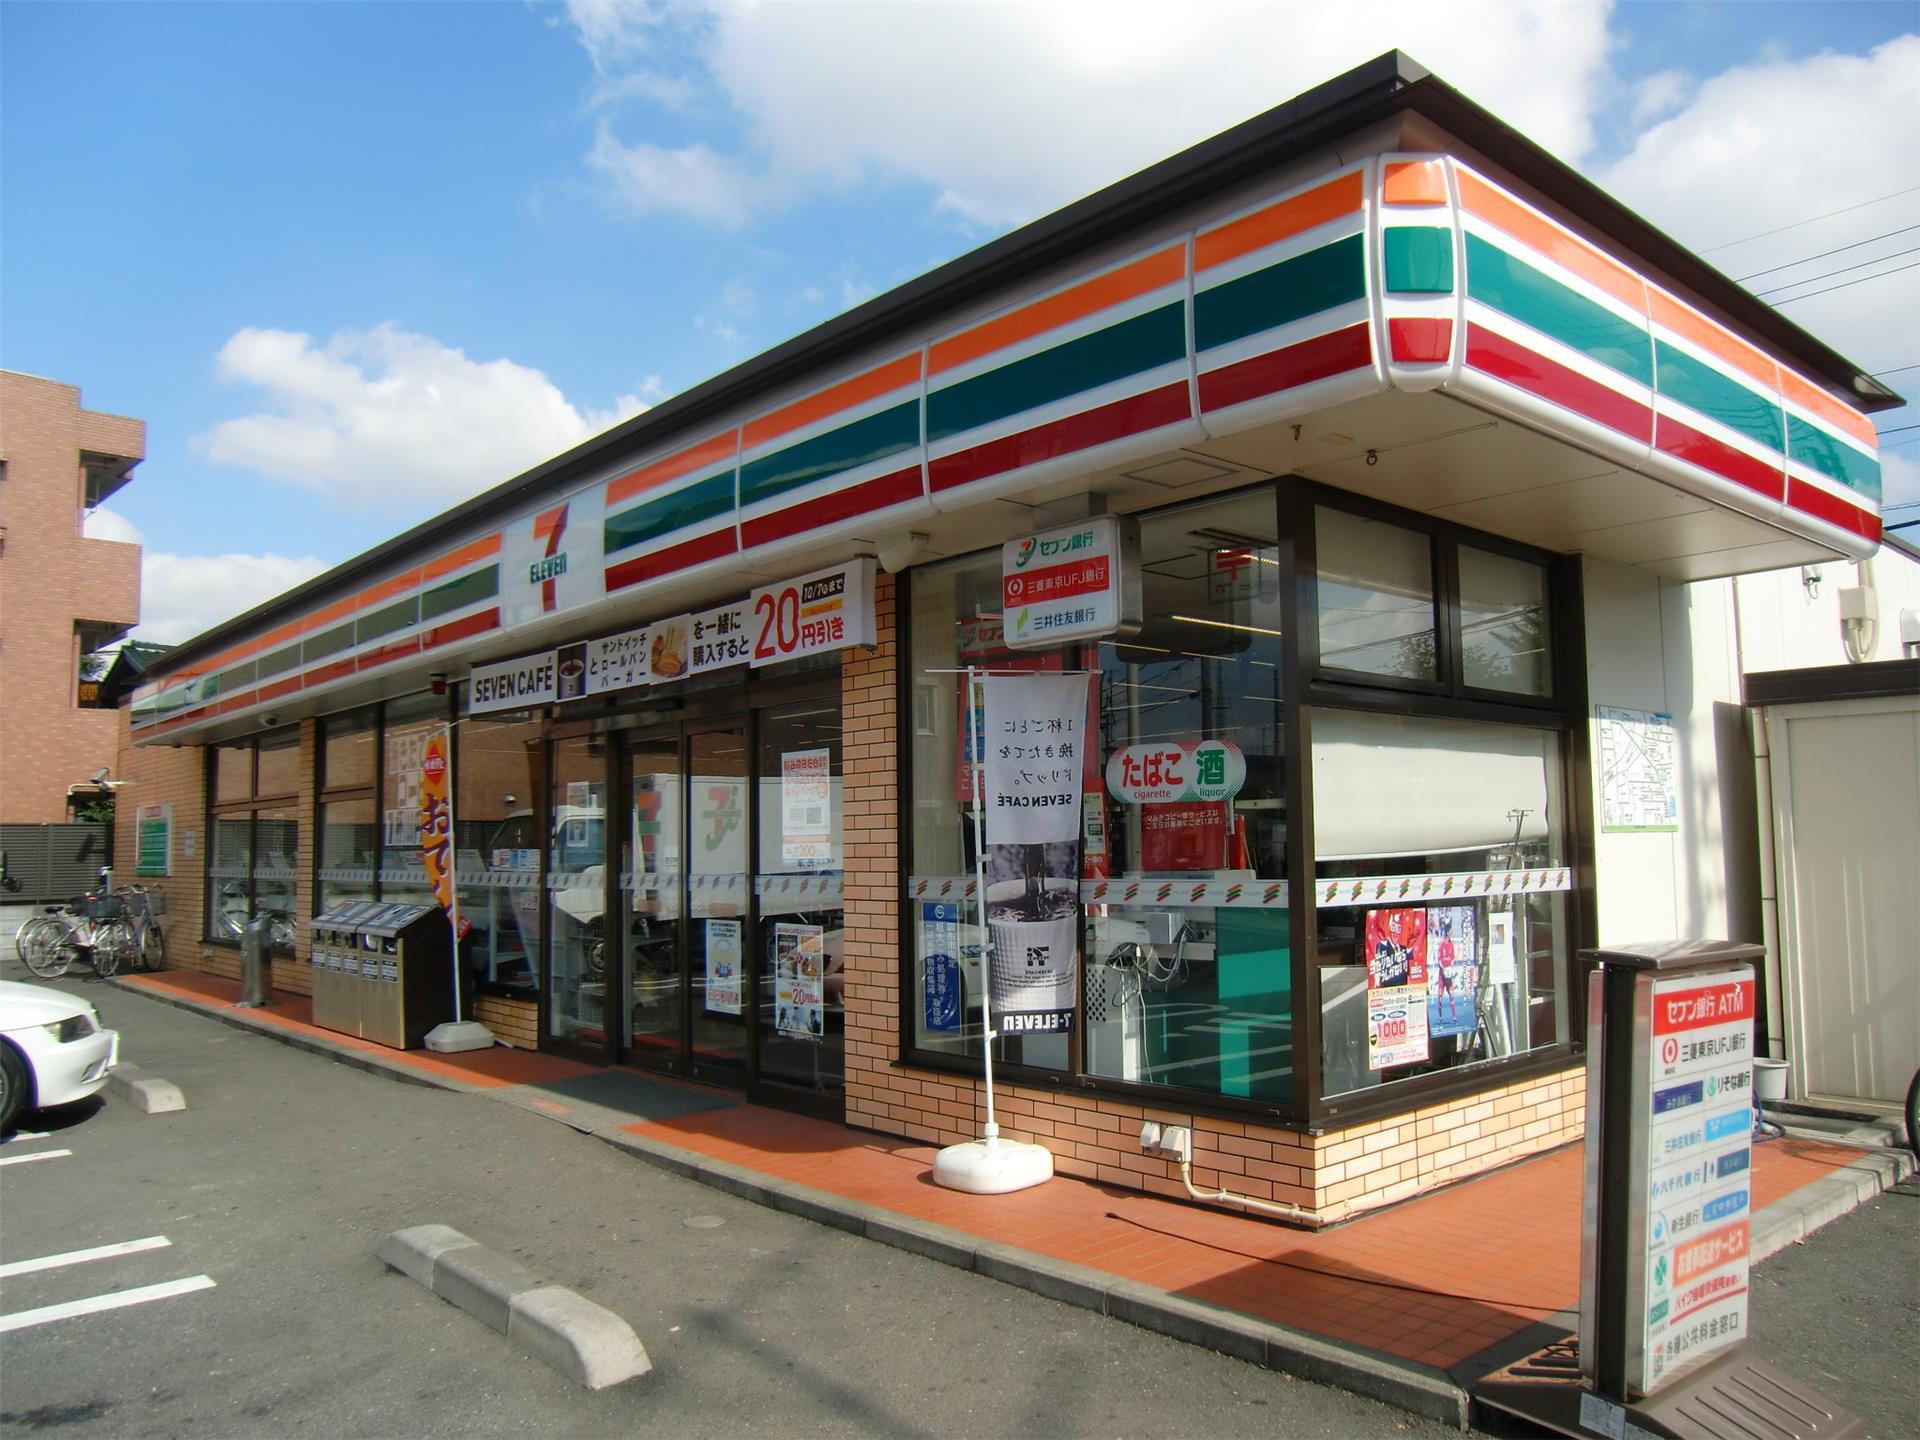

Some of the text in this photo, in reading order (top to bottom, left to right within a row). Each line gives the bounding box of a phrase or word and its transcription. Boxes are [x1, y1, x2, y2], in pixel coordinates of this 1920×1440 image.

[1040, 531, 1094, 557] セブン銀行
[1027, 567, 1104, 594] 三菱東京UFJ銀行
[694, 611, 742, 640] を一緒に
[755, 587, 799, 660] 20
[1034, 607, 1095, 630] 三井住友銀行
[602, 633, 647, 656] サンドイッチ
[801, 616, 844, 649] 円引き
[602, 651, 647, 671] ロールパン
[693, 635, 750, 667] 購入すると
[475, 656, 553, 702] SEVEN CAFÉ
[590, 656, 598, 676] と
[601, 669, 647, 687] バーガー
[1122, 751, 1184, 787] たばこ
[1197, 749, 1225, 785] 酒
[1134, 789, 1171, 800] cigarette
[1200, 787, 1226, 798] liquor
[792, 988, 804, 1004] 20
[1667, 992, 1744, 1024] セブン銀行 ATM
[1377, 1020, 1406, 1038] 1000
[1682, 1033, 1746, 1062] 三菱東京UFJ銀行
[1717, 1071, 1750, 1093] りそな銀行
[1665, 1130, 1701, 1153] 三井住友銀行
[1660, 1168, 1700, 1195] 八千代銀行
[1671, 1209, 1699, 1234] 新生銀行
[1666, 1312, 1739, 1360] 各種公共料金窓口
